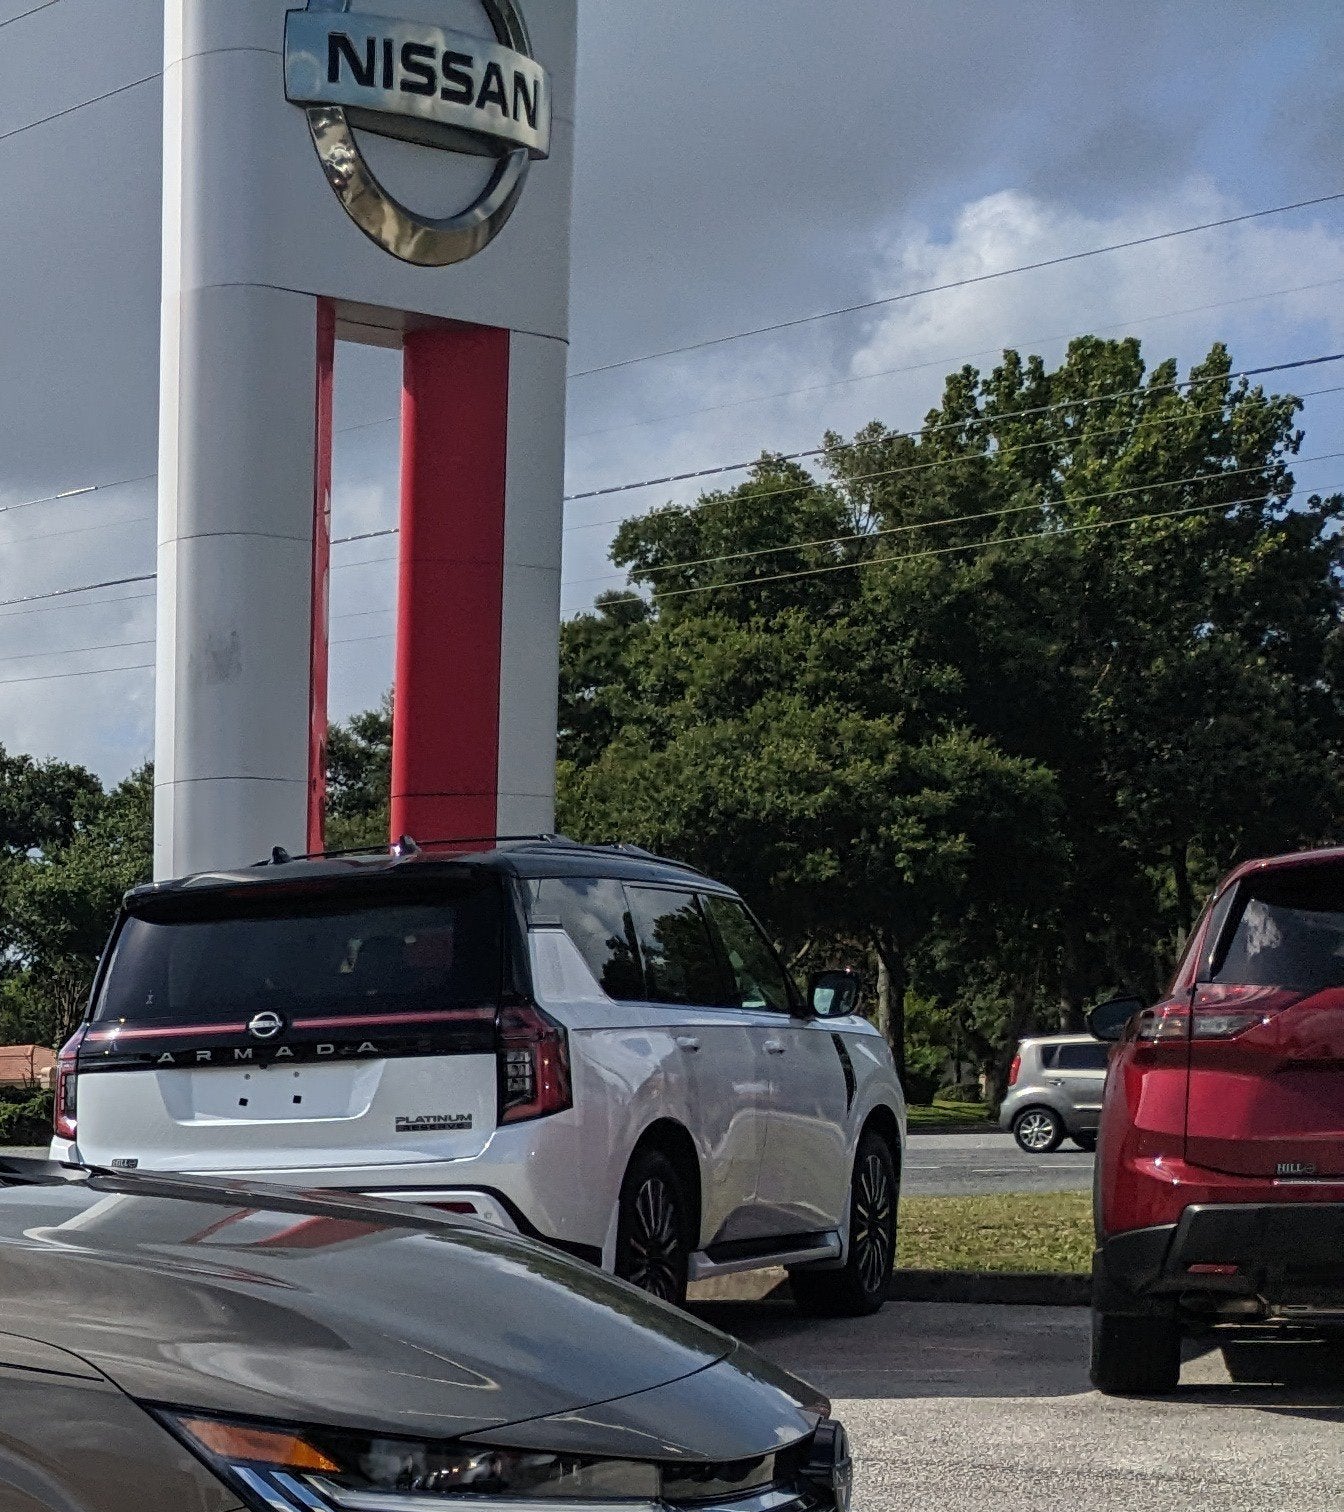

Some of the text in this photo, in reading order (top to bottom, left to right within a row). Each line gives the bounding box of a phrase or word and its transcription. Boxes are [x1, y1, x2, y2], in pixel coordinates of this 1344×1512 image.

[327, 31, 538, 130] NISSAN
[157, 1041, 379, 1064] ARMADA
[395, 1113, 472, 1124] PLATINUM
[1277, 1163, 1302, 1172] HILL
